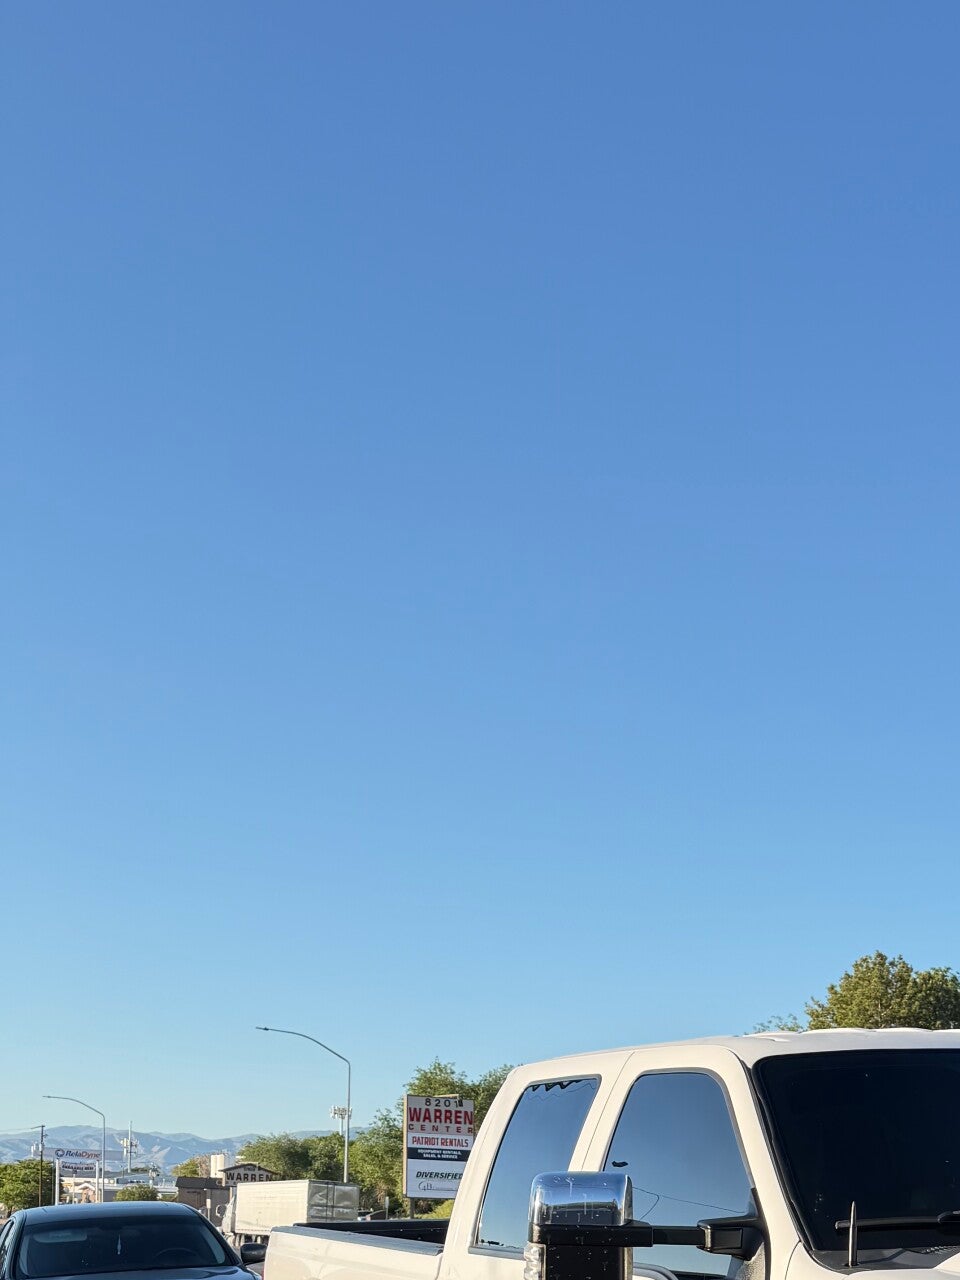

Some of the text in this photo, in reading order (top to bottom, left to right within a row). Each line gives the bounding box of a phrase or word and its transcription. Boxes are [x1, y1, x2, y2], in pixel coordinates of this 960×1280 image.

[409, 1107, 473, 1125] WARREN
[408, 1124, 474, 1134] CENTER
[412, 1136, 469, 1148] PATRIOT RENTALS
[226, 1172, 273, 1182] WARREN
